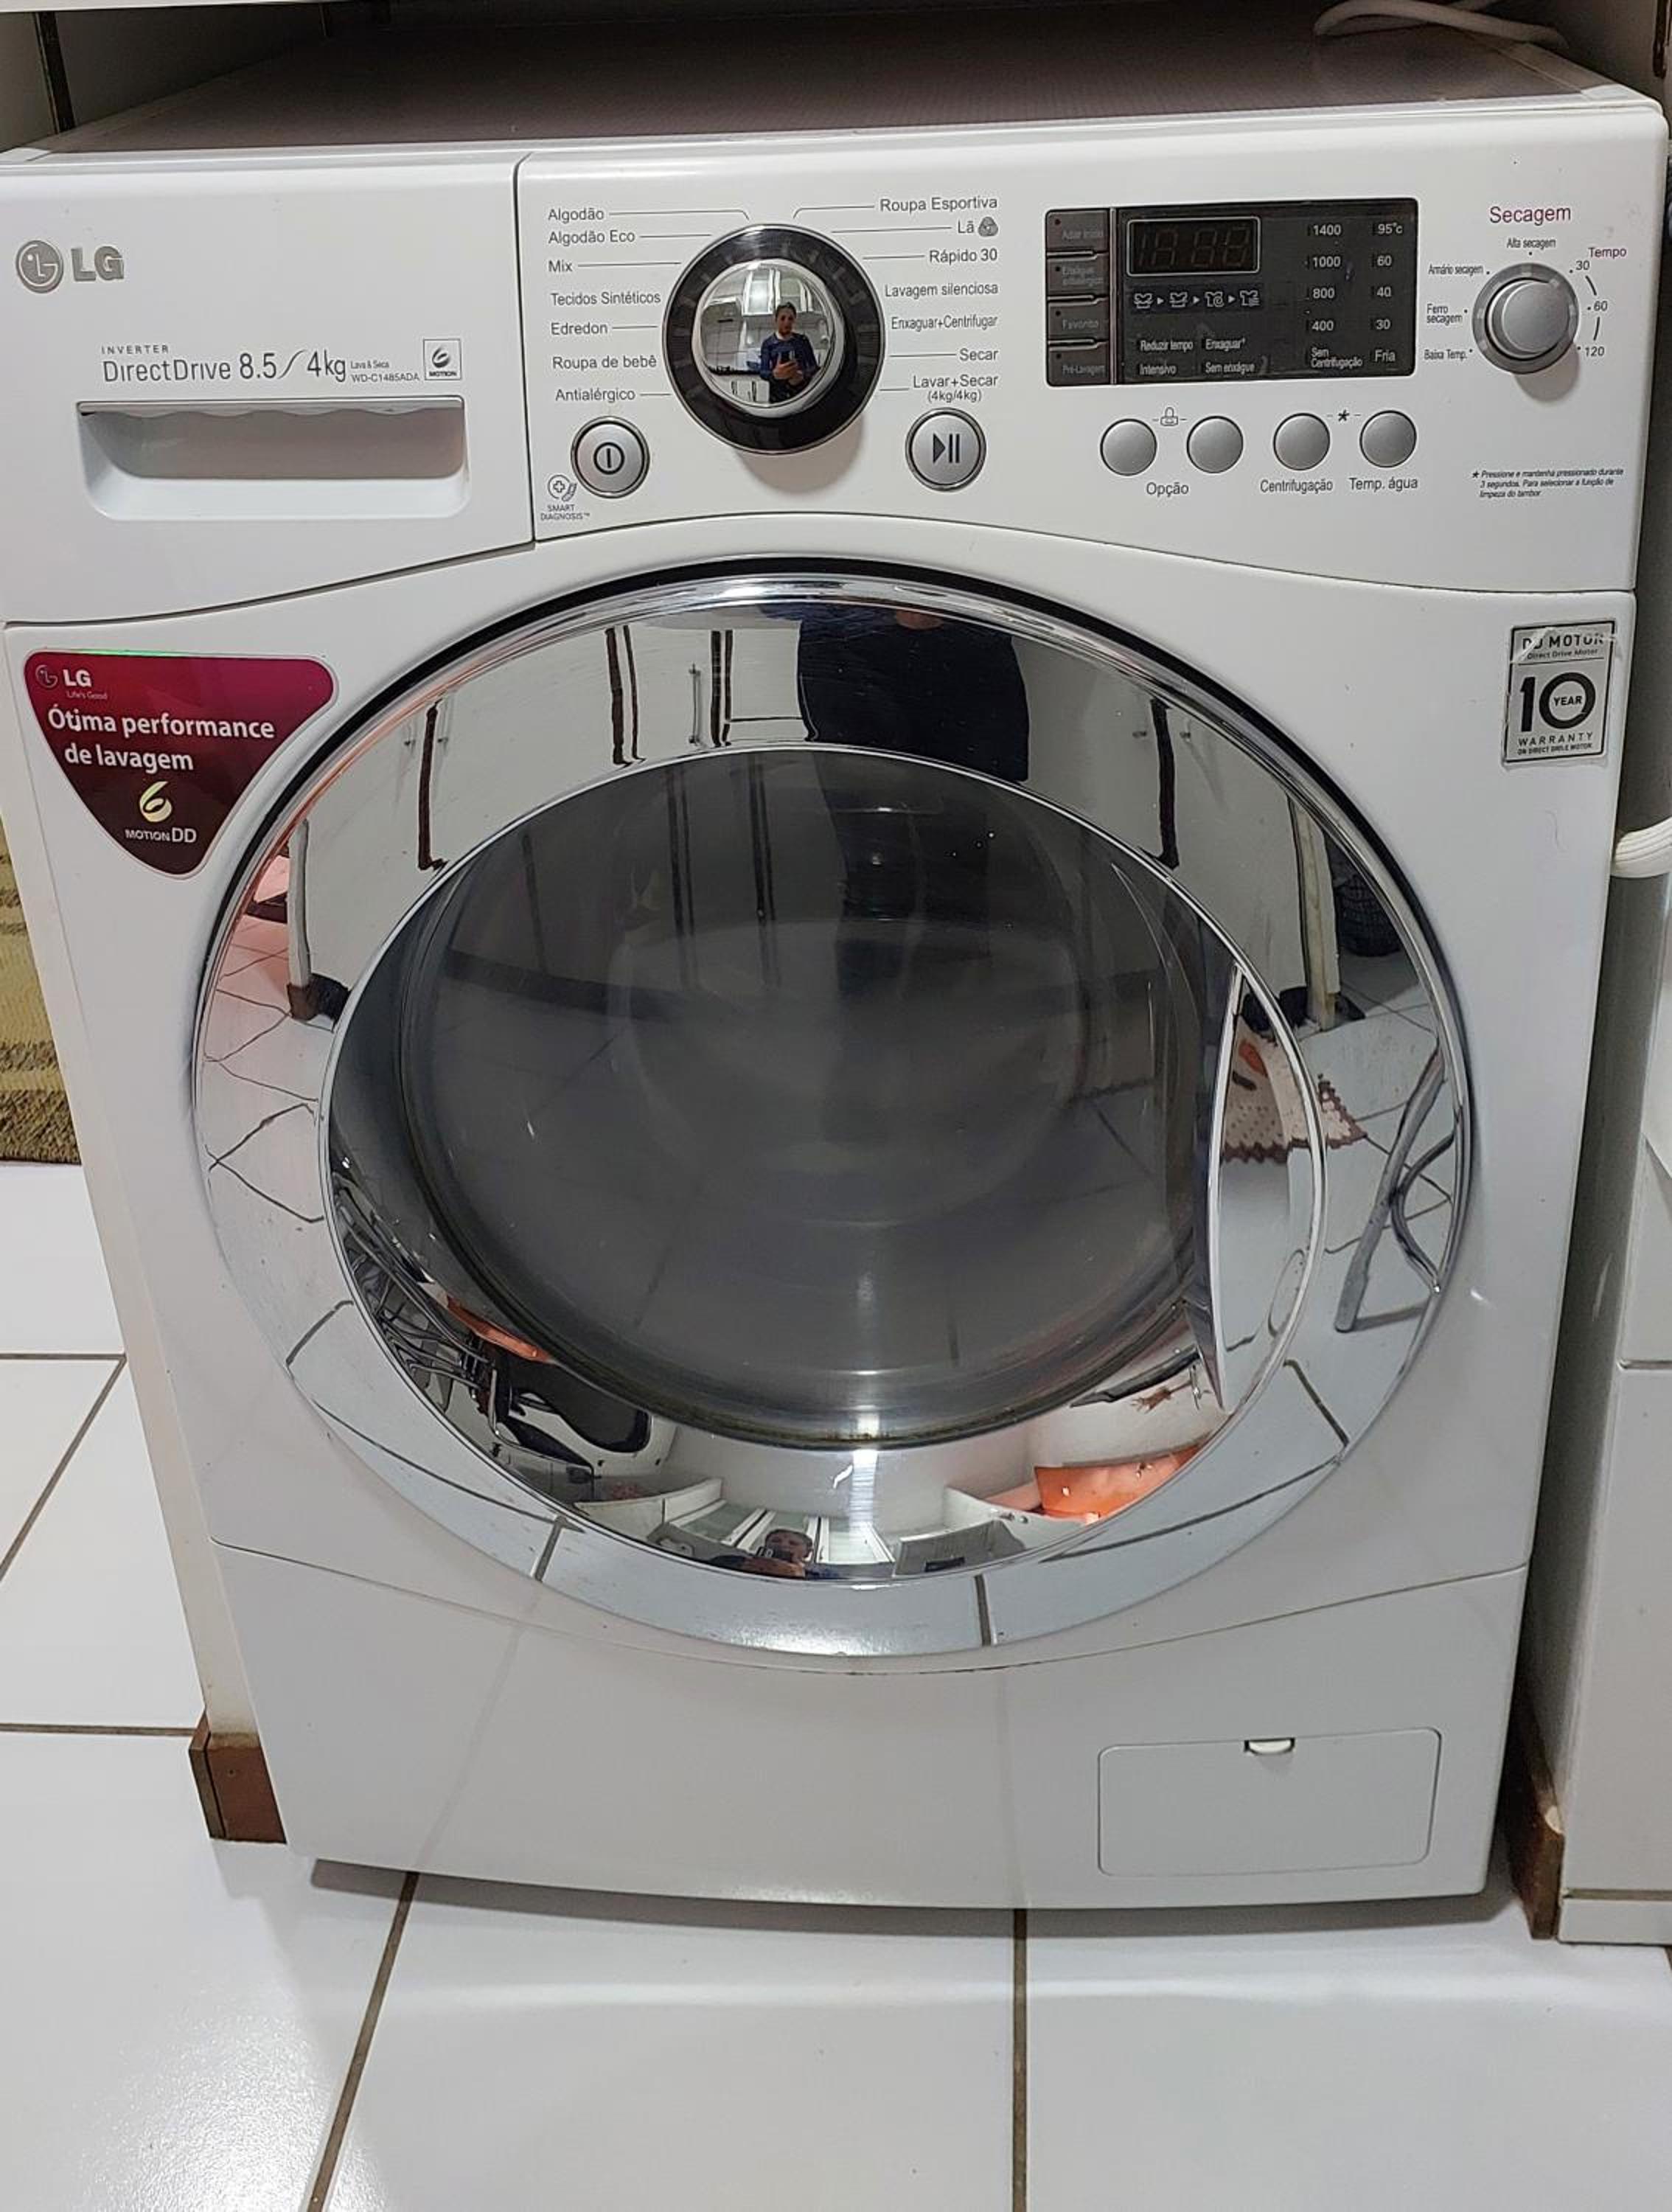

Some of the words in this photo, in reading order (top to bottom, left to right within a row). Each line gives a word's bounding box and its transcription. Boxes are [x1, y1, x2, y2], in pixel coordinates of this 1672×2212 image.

[880, 199, 926, 214] Roupa
[931, 197, 998, 212] Esportiva
[548, 208, 605, 224] Algodão
[1489, 206, 1571, 226] Secagem
[958, 221, 975, 234] Lã
[1313, 224, 1342, 235] 1400
[548, 230, 605, 246] Algodão
[610, 230, 635, 243] Eco
[1506, 238, 1520, 248] Alta
[1523, 238, 1556, 251] secagem
[930, 249, 977, 265] Rápido
[981, 249, 998, 262] 30
[1588, 246, 1627, 260] Tempo
[72, 246, 125, 282] LG
[548, 260, 573, 273] Mix
[1312, 256, 1341, 267] 1000
[1376, 255, 1392, 266] 60
[1576, 260, 1590, 271] 30
[1455, 265, 1484, 276] secagem
[885, 284, 938, 299] Lavagem
[941, 282, 998, 296] silenciosa
[1313, 288, 1335, 299] 800
[1376, 286, 1392, 297] 40
[551, 293, 597, 306] Tecidos
[601, 291, 661, 306] Sintéticos
[1427, 303, 1449, 314] Ferro
[1594, 301, 1609, 312] 60
[891, 315, 998, 331] Enxaguar+Centrifugar
[1312, 320, 1334, 331] 400
[1376, 319, 1391, 330] 30
[1427, 314, 1463, 325] secagem
[551, 321, 608, 335] Edredon
[102, 344, 170, 355] INVERTER
[1140, 340, 1168, 351] Reduzir
[1170, 339, 1194, 352] tempo
[959, 348, 998, 362] Secar
[1311, 347, 1328, 358] Sem
[1375, 349, 1396, 362] Fria
[1424, 349, 1444, 361] Baixa
[1446, 349, 1467, 361] Temp.
[1585, 347, 1606, 358] 120
[552, 356, 598, 370] Roupa
[603, 355, 619, 369] de
[622, 355, 657, 369] bebê
[1205, 361, 1223, 374] Sem
[1311, 357, 1363, 369] Centrifugação
[1140, 364, 1177, 375] Intensivo
[913, 375, 998, 389] Lavar+Secar
[555, 387, 635, 403] Antialérgico
[927, 390, 982, 403] (4kg/4kg)
[1146, 481, 1189, 497] Opção
[1260, 479, 1333, 495] Centrifugação
[1349, 476, 1385, 490] Temp.
[1389, 476, 1418, 492] água
[63, 669, 91, 687] LG
[1519, 672, 1596, 732] 10
[1553, 695, 1583, 706] YEAR
[48, 703, 117, 732] Ótima
[122, 712, 275, 739] performance
[1518, 731, 1592, 746] WARRANTY
[65, 742, 92, 765] de
[97, 743, 194, 773] lavagem
[125, 829, 170, 842] MOTION
[172, 827, 198, 844] DD
